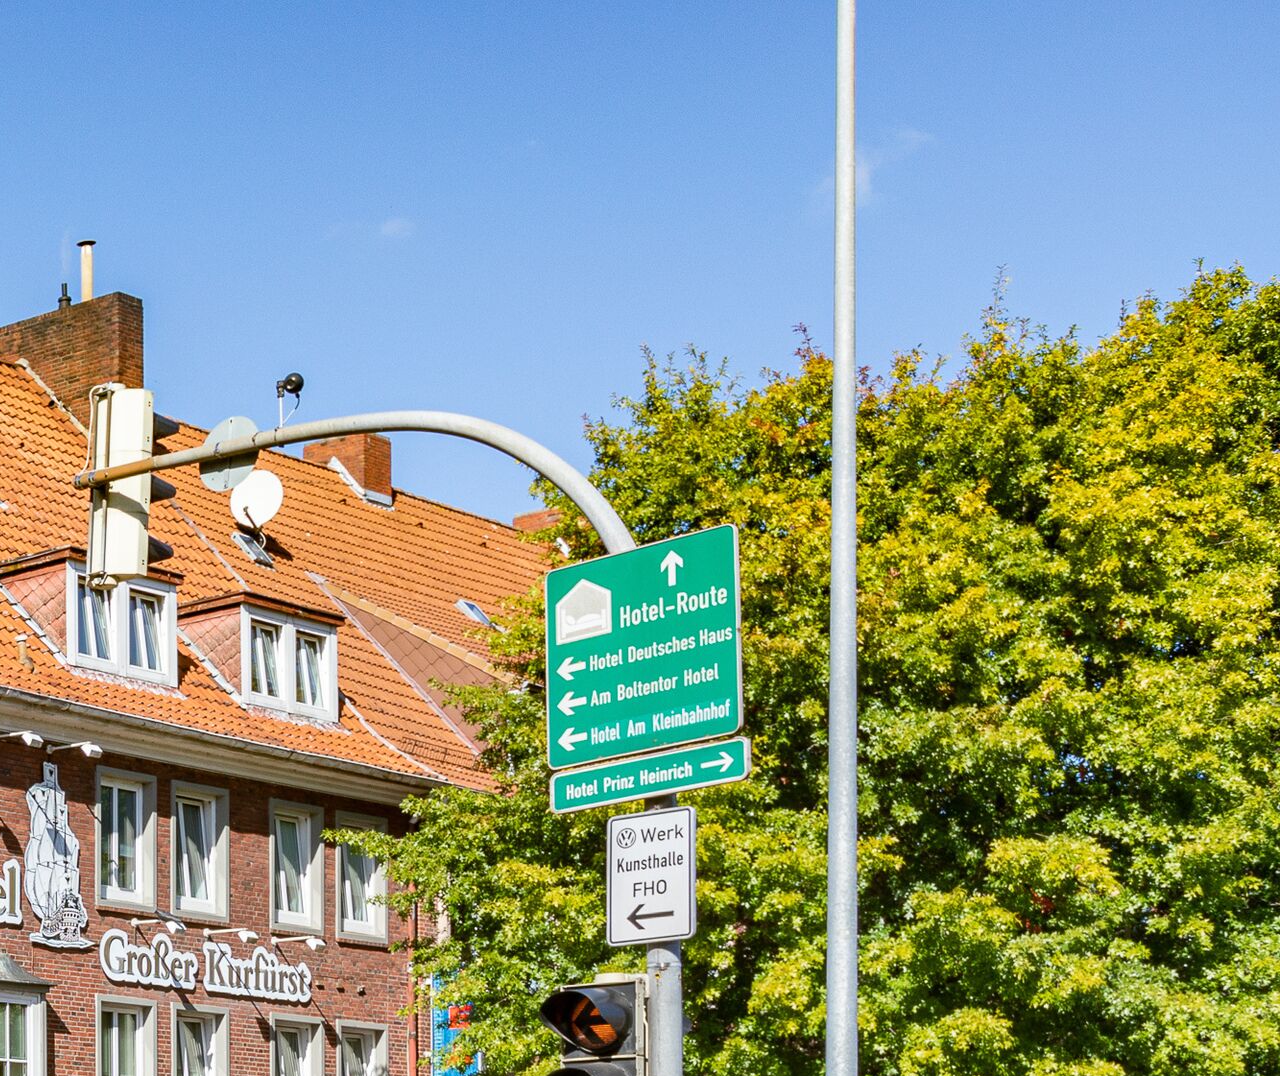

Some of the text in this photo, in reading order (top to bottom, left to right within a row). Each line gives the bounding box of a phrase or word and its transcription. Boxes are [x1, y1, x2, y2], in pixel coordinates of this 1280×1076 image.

[620, 586, 728, 628] Hotel-Route
[589, 627, 733, 671] Hotel Deutsches Haus
[590, 662, 719, 707] Am Boltentor Hotel
[591, 698, 731, 745] Hotel Am Kleinbahnhof
[566, 761, 693, 800] Hotel Prinz Heinrich
[641, 824, 684, 843] Werk
[617, 851, 684, 874] Kunsthalle
[633, 879, 667, 898] FHO
[104, 935, 309, 997] Großer Kurfürst
